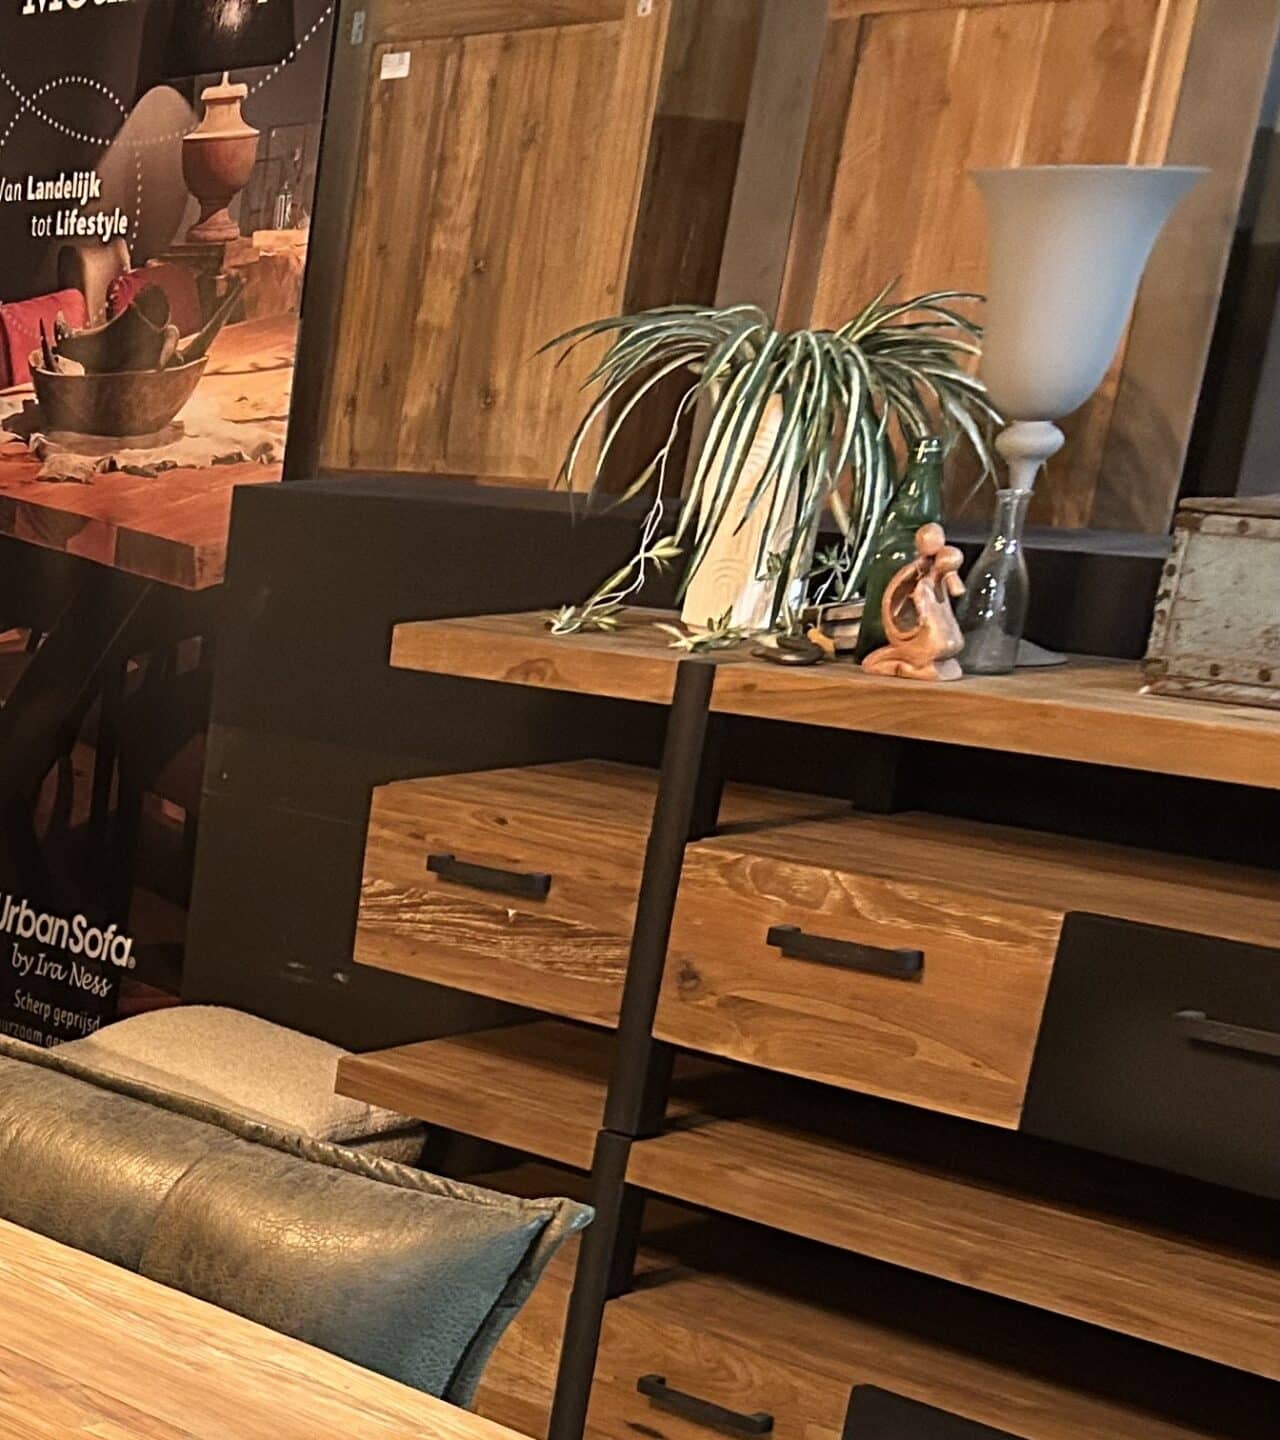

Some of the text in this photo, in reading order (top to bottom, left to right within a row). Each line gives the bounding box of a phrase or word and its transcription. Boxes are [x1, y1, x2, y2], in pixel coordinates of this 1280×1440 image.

[27, 171, 101, 206] Landelijk
[32, 207, 128, 242] tot Lifestyle
[11, 943, 112, 997] by Ira Ness
[14, 989, 101, 1035] Scherp geprijsd
